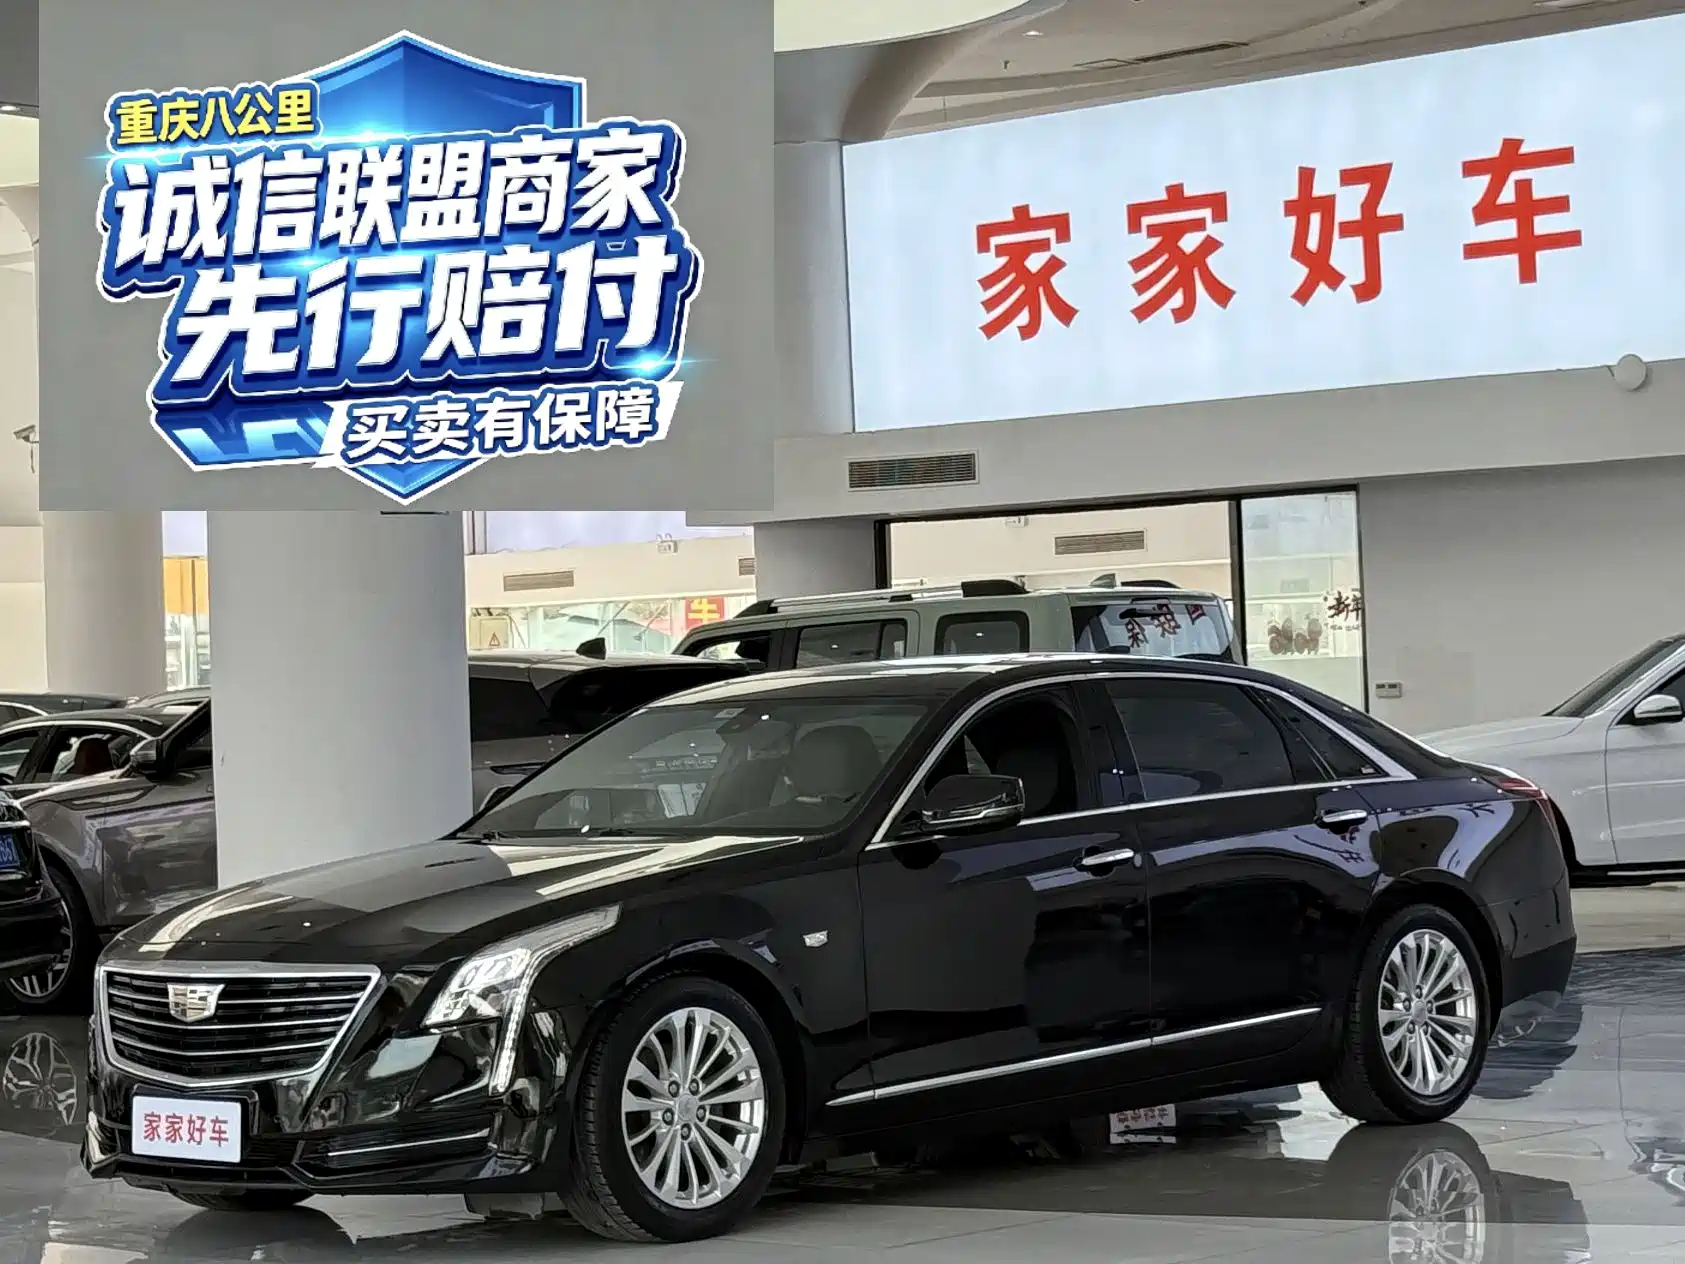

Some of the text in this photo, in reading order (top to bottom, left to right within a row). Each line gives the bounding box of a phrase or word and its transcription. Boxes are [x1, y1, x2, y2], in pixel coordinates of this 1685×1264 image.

[975, 137, 1583, 342] 家家好车
[143, 1111, 229, 1147] 家家好车
